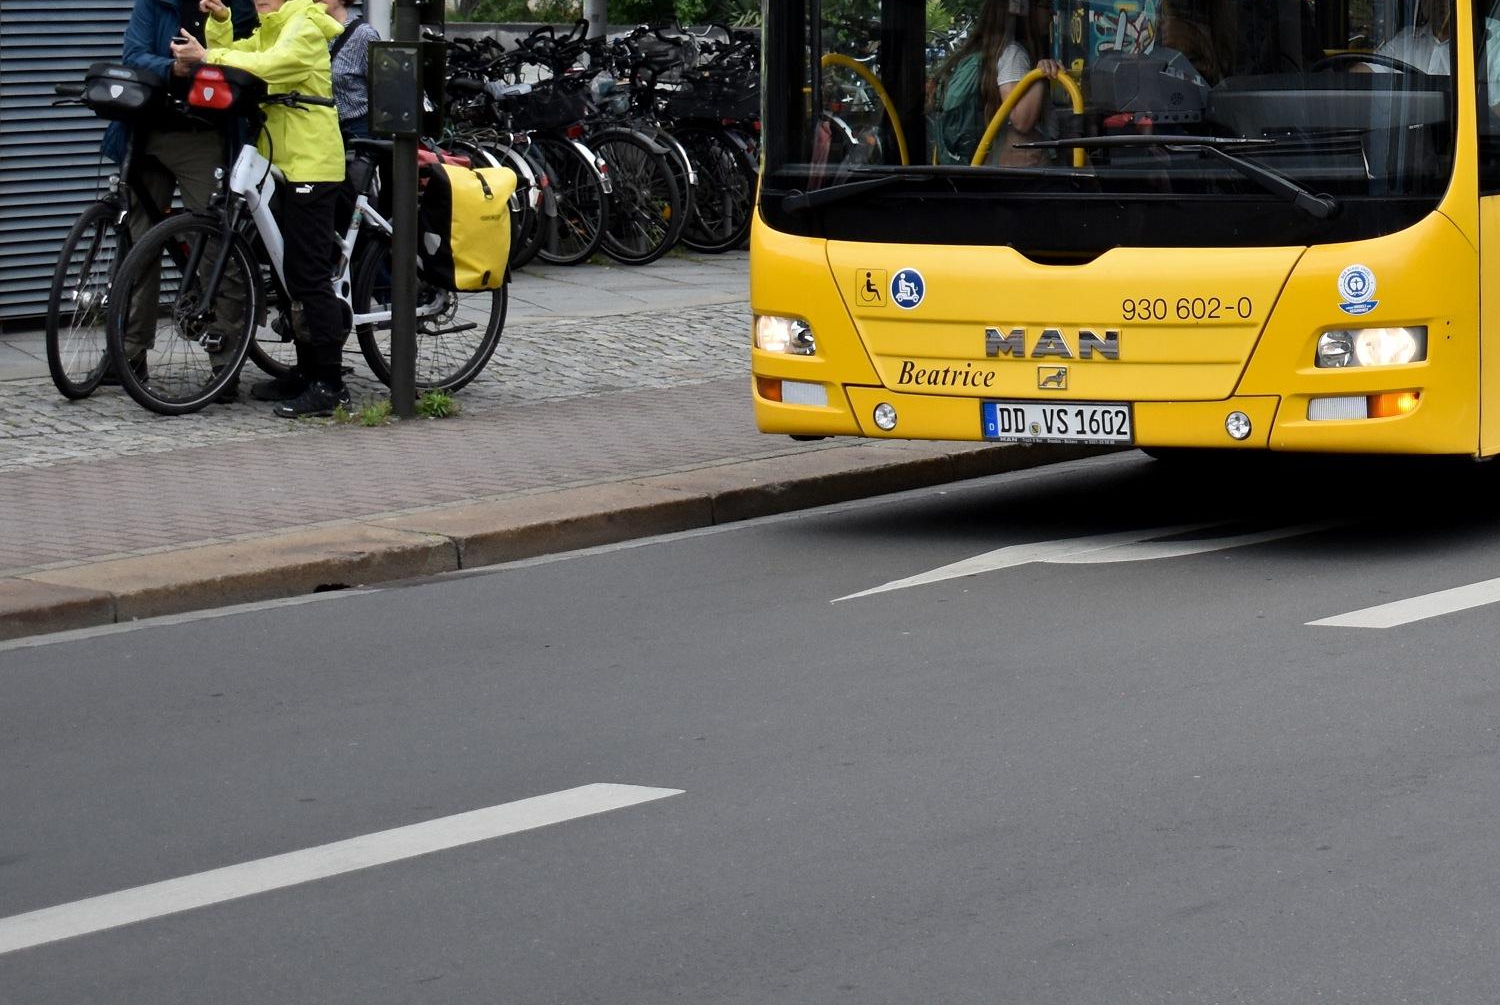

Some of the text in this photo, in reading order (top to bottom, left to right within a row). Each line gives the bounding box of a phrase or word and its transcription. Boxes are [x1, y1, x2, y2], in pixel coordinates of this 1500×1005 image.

[1122, 296, 1253, 321] 930 602-0
[984, 325, 1122, 360] MAN
[897, 360, 996, 388] Beatrice
[999, 407, 1128, 436] DD VS 1602
